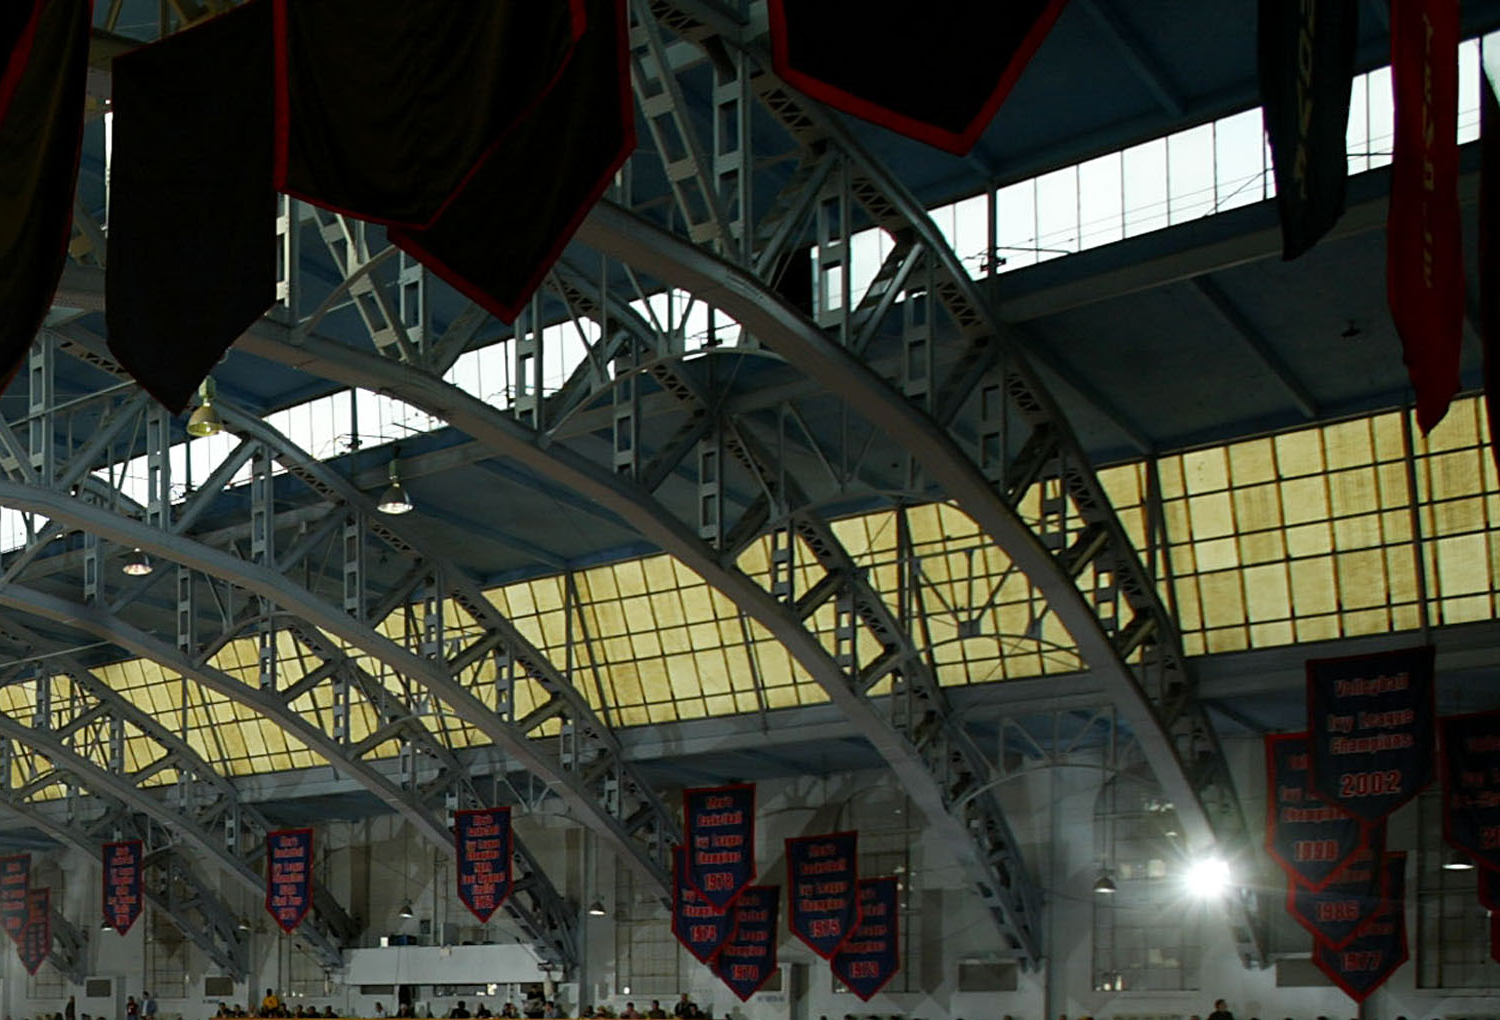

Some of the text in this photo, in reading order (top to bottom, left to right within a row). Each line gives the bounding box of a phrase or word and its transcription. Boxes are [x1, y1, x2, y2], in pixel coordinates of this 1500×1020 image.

[1328, 709, 1416, 733] Ivy League
[1332, 734, 1415, 756] Champions
[1340, 770, 1403, 798] 2002
